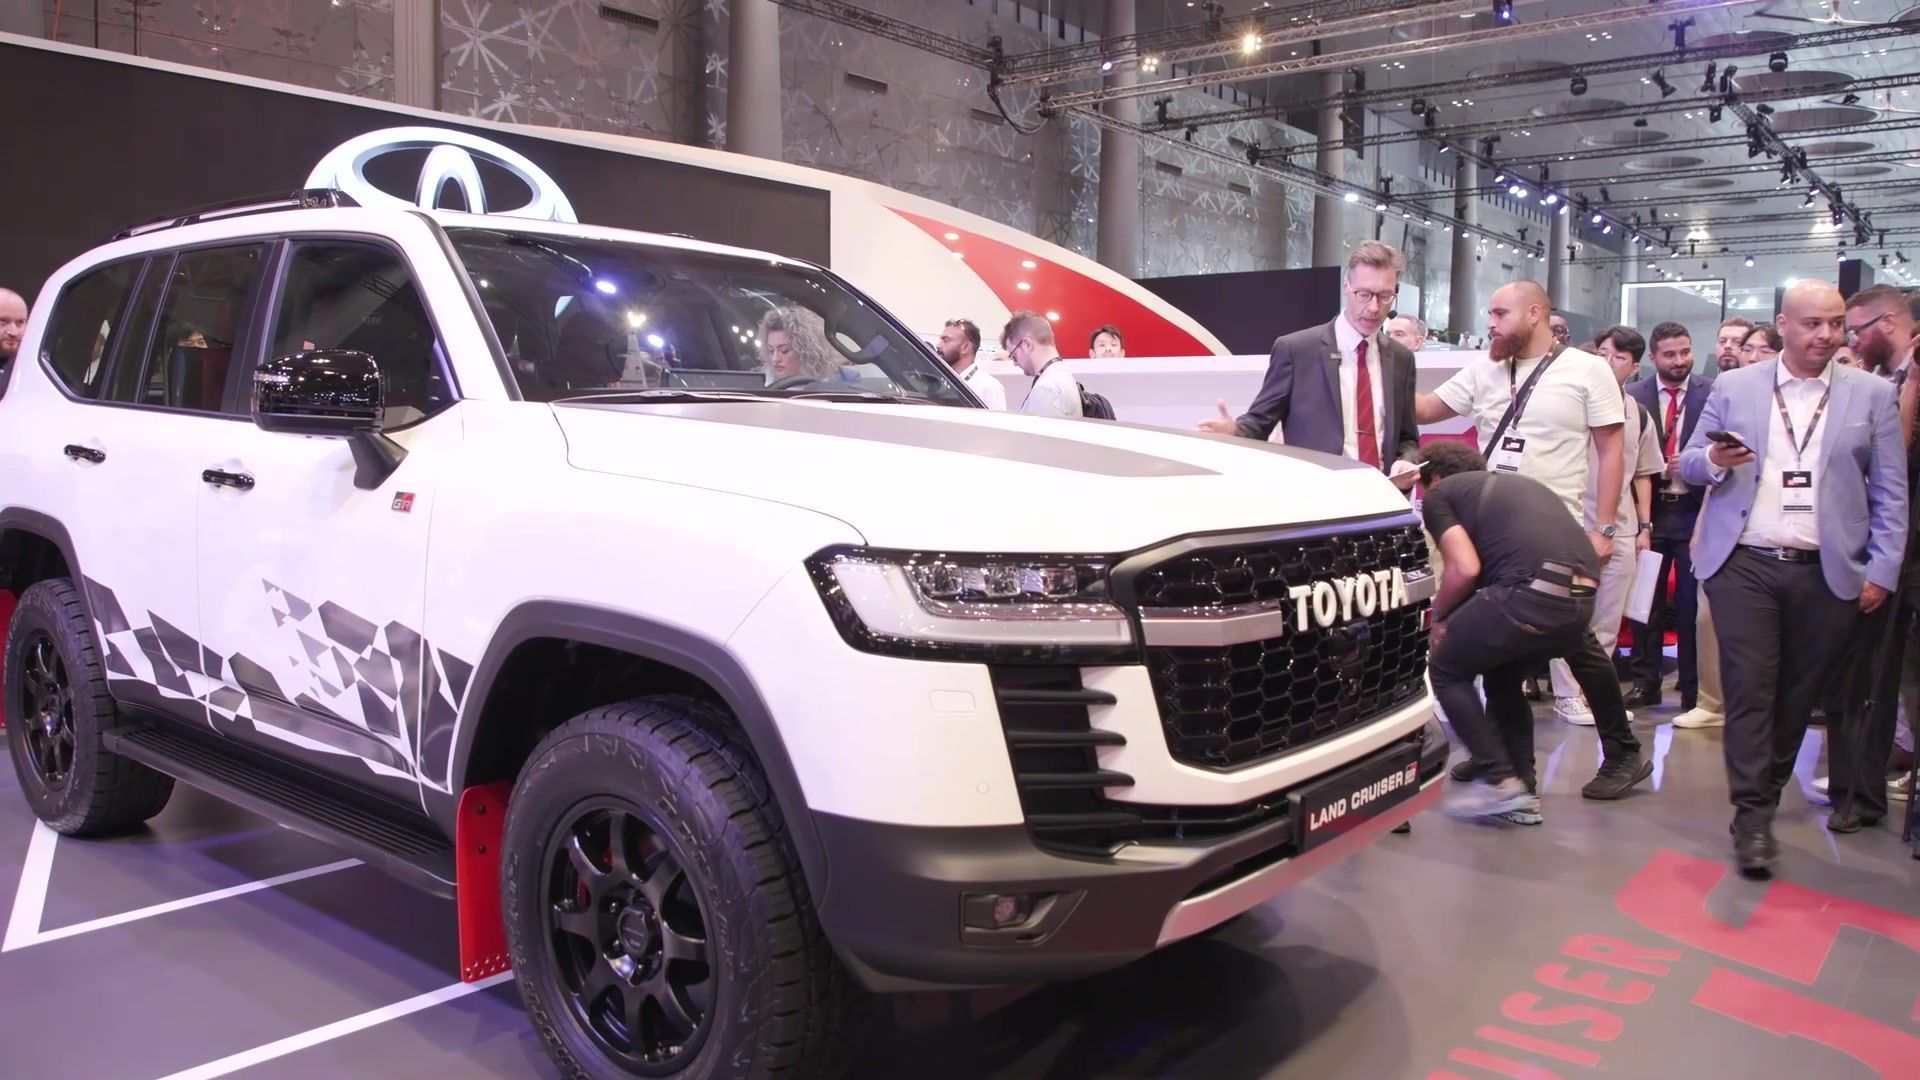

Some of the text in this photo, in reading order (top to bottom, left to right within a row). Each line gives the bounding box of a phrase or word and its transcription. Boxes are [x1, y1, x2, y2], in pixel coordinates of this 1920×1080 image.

[393, 498, 412, 513] GR
[1288, 566, 1409, 632] TOYOTA
[1310, 798, 1347, 831] LAND
[1351, 770, 1403, 810] CRUISER
